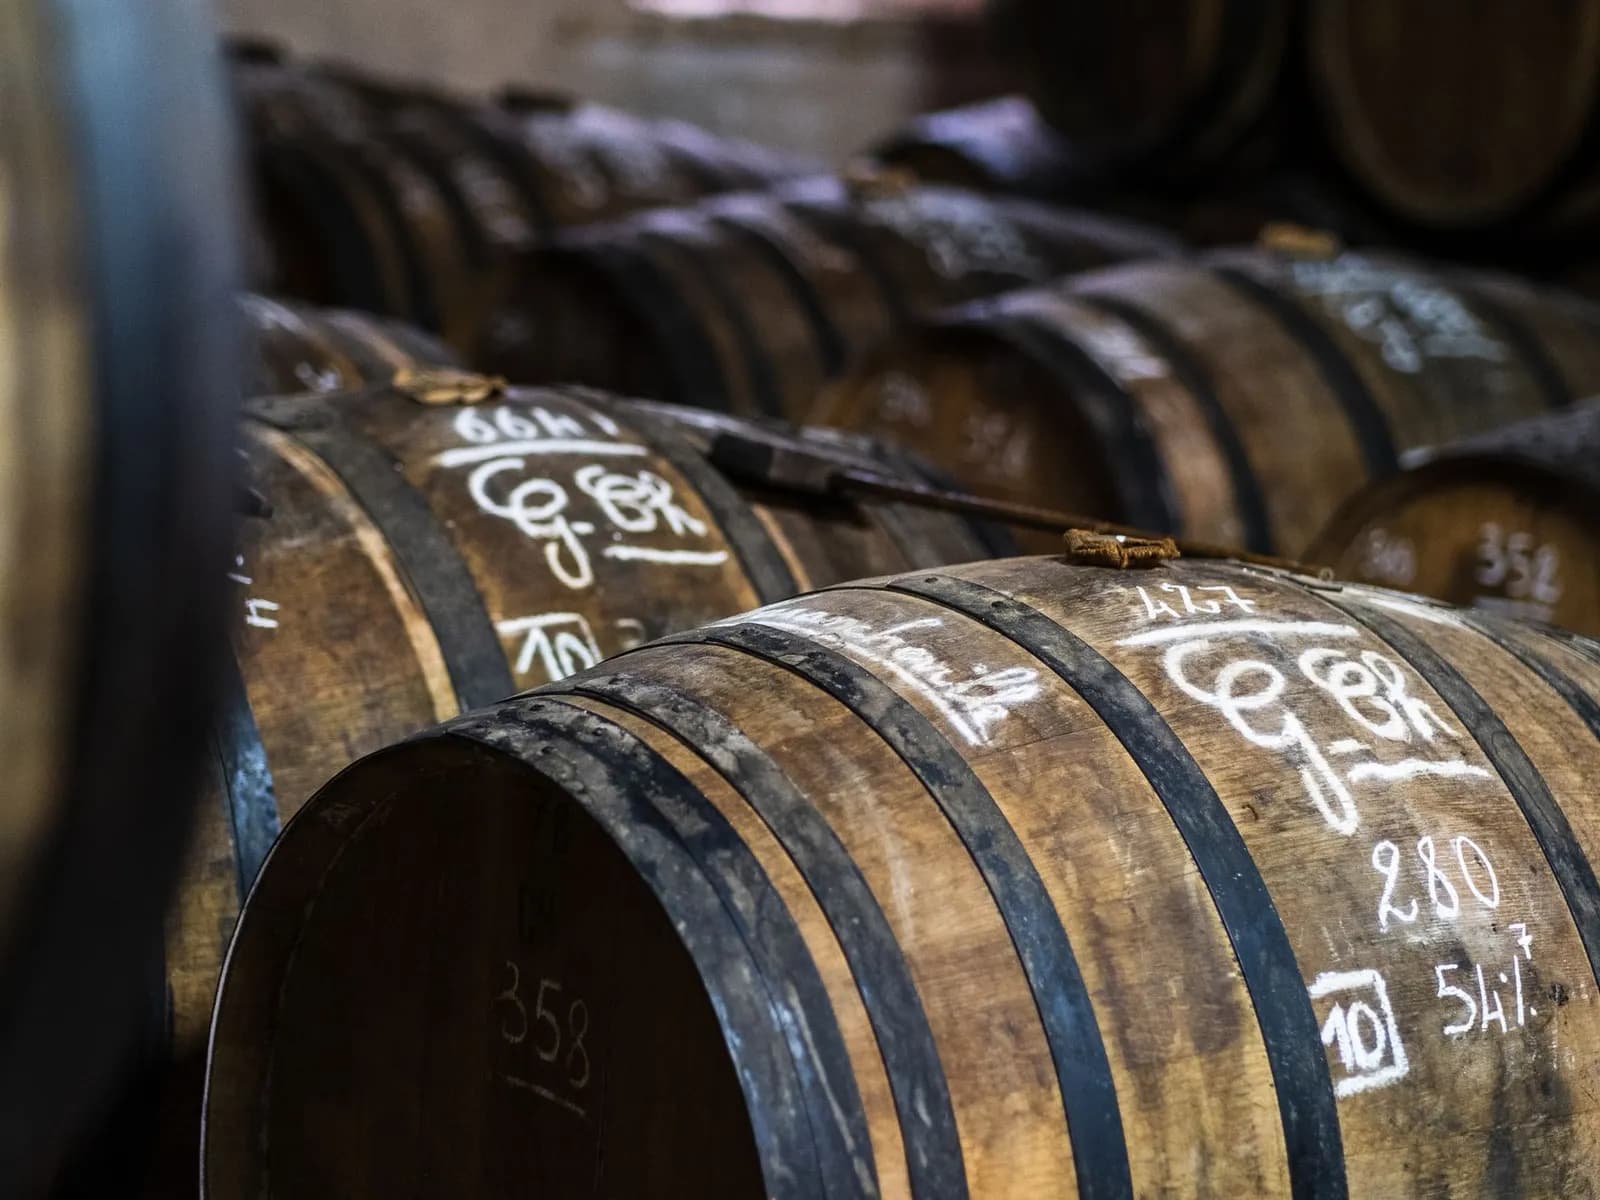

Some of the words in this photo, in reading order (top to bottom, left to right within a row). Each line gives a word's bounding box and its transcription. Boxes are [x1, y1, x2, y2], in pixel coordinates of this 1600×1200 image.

[1134, 582, 1256, 620] 427
[1371, 835, 1500, 933] 280
[495, 959, 590, 1089] 358
[1320, 1000, 1386, 1073] 10
